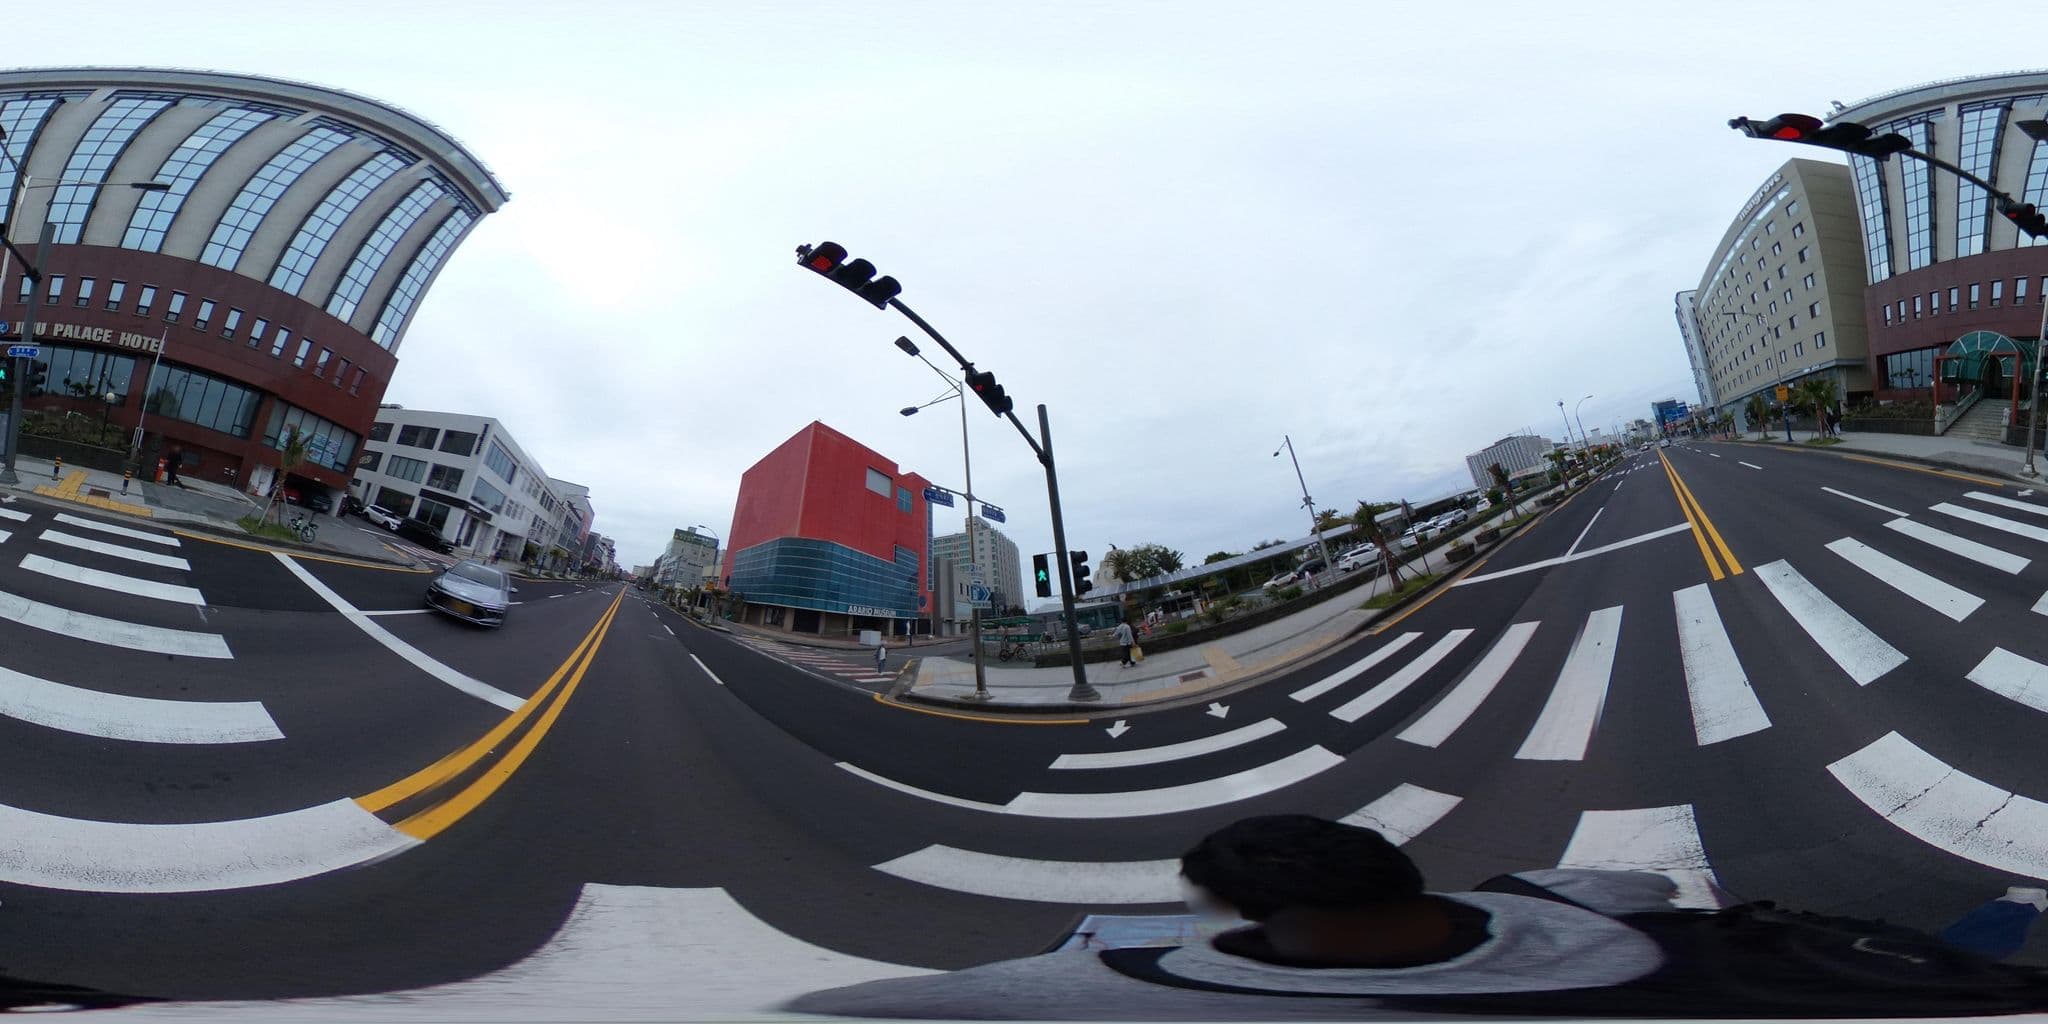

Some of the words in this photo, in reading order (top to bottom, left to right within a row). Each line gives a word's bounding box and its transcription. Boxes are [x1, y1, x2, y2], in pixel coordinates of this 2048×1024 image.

[1739, 172, 1781, 220] mangrove
[12, 321, 47, 335] JU
[53, 322, 113, 343] PALACE
[848, 605, 873, 616] ARARIO
[874, 607, 897, 618] MUSE
